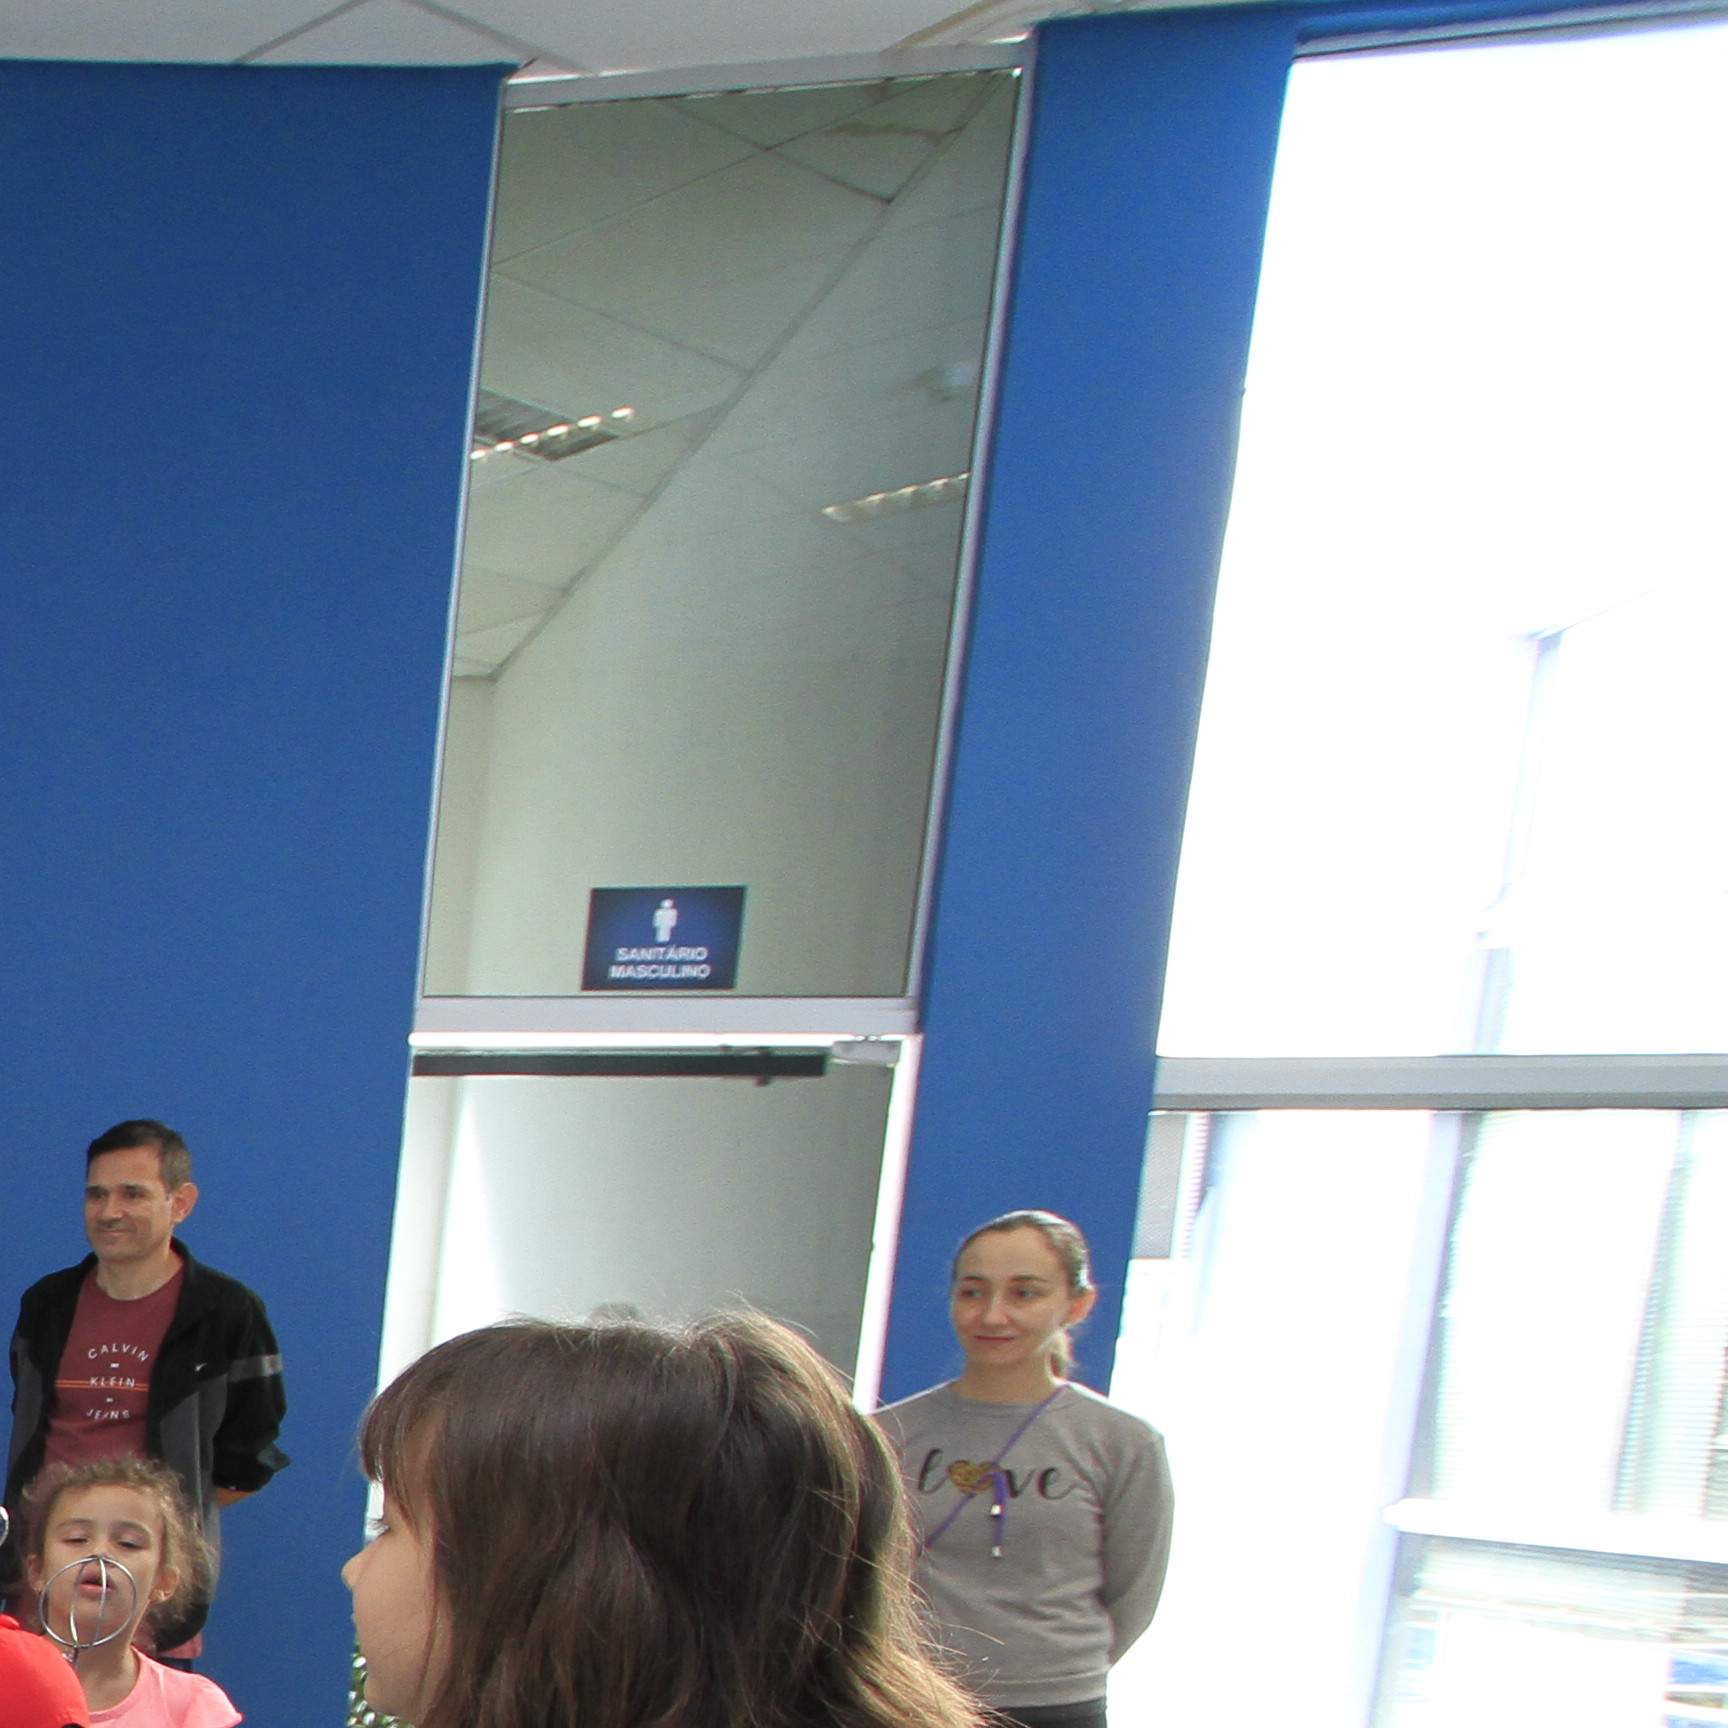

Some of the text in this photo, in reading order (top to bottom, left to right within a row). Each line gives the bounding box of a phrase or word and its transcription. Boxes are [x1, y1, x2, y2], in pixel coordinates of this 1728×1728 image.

[615, 944, 708, 961] SANITÁRIO
[608, 964, 712, 979] MASCULINO
[88, 1343, 149, 1362] CALVIN
[90, 1377, 135, 1388] KLEIN
